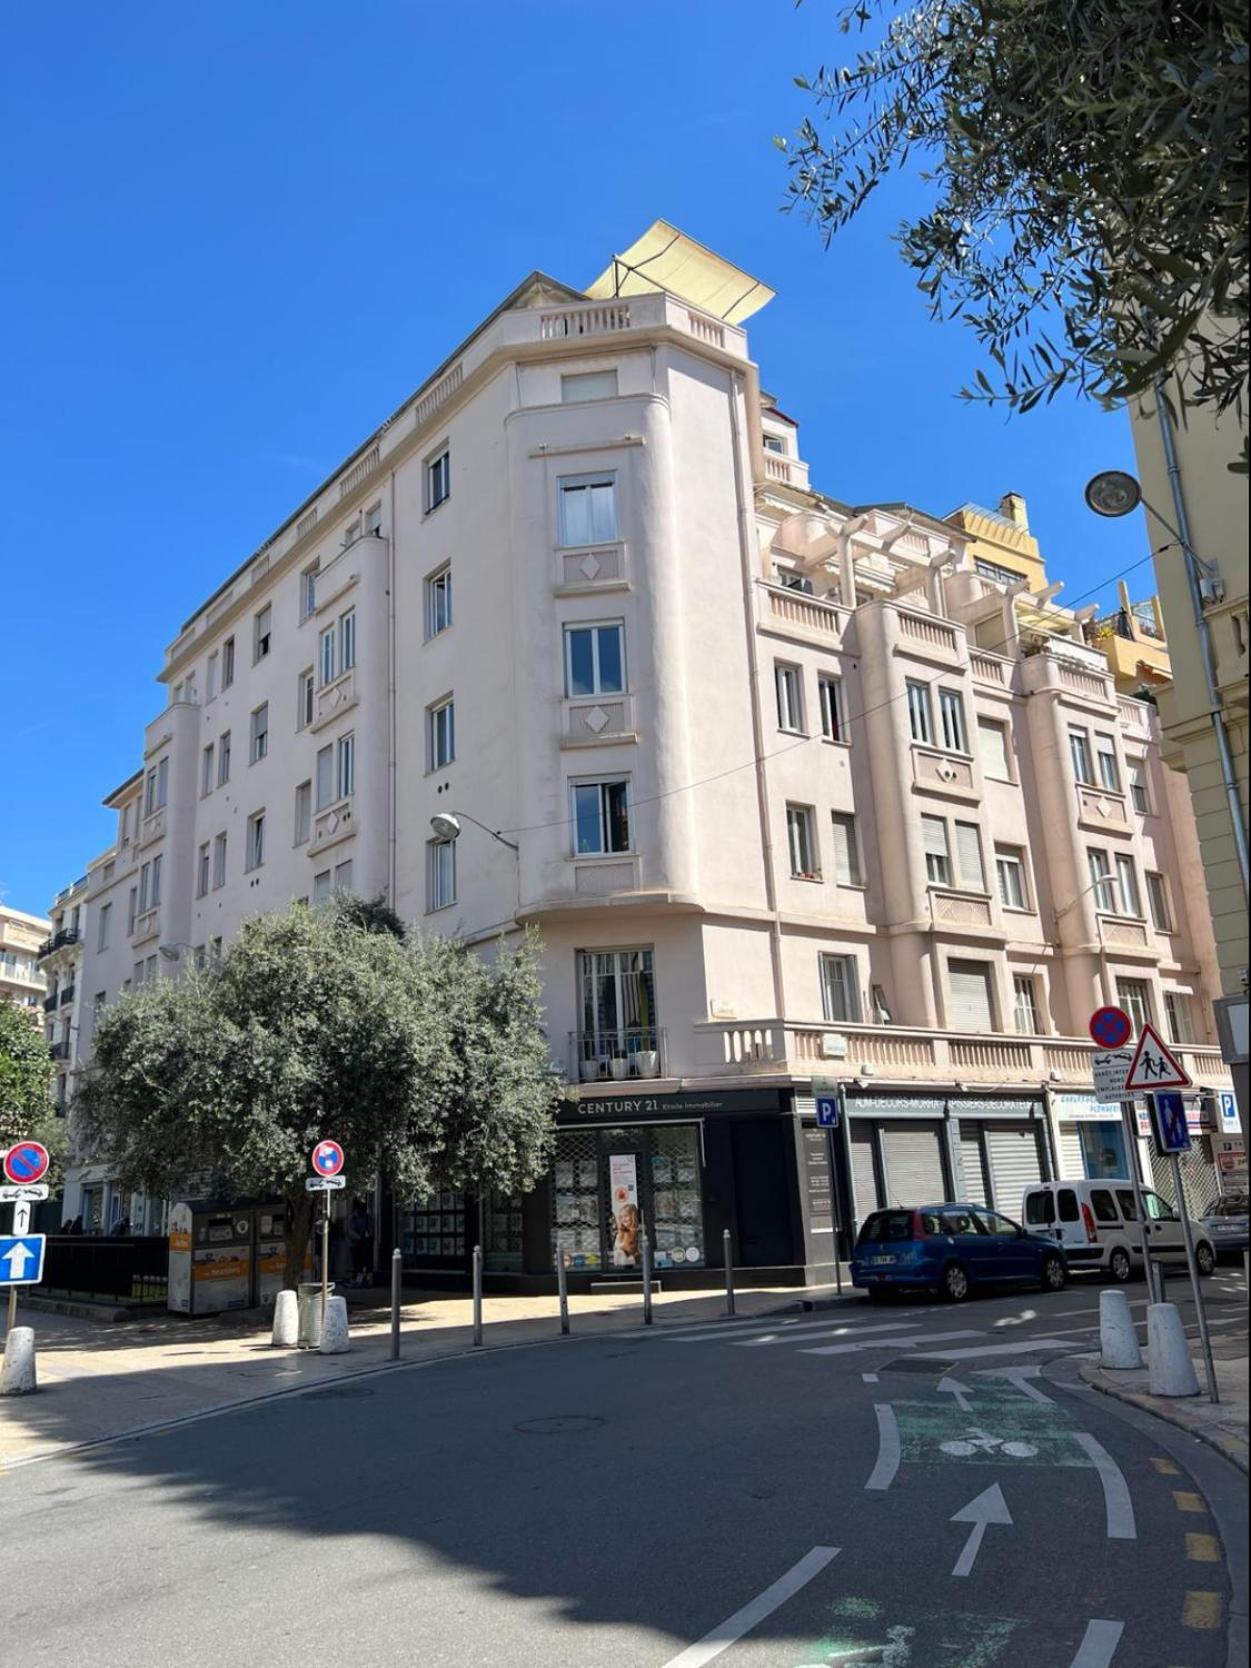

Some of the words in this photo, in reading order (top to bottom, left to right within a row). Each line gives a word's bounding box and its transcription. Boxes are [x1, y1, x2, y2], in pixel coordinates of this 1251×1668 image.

[577, 1100, 642, 1114] CENTURY
[645, 1100, 658, 1111] 21
[822, 1103, 831, 1121] P
